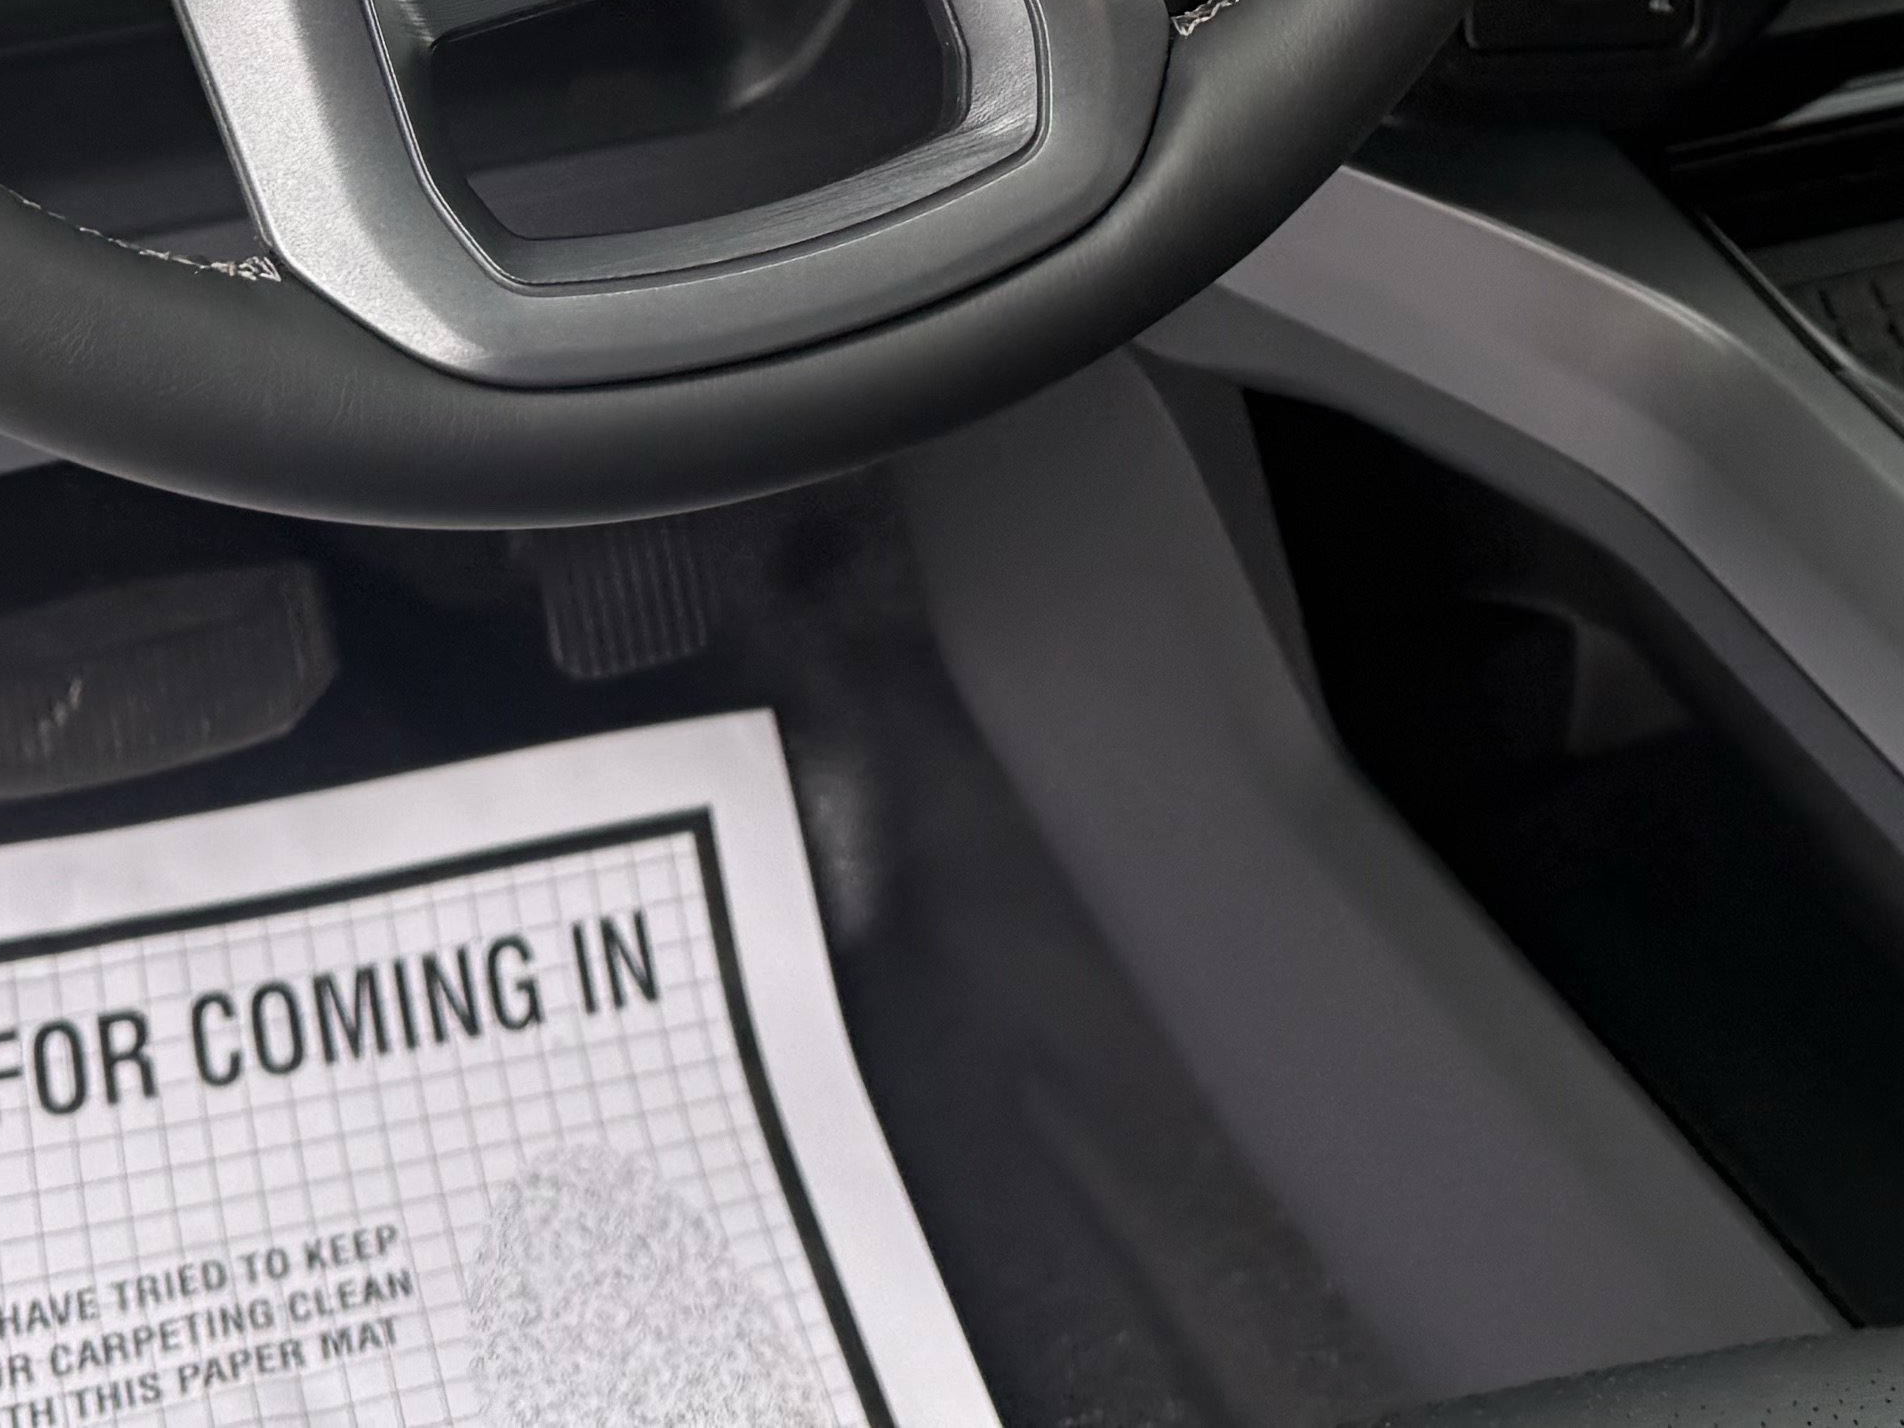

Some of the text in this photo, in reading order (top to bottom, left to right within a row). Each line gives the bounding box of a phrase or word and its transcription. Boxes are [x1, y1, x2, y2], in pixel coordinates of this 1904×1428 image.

[190, 932, 545, 1087] COMING
[571, 907, 663, 1016] IN
[110, 1260, 228, 1314] TRIED
[241, 1246, 291, 1285] TO
[304, 1223, 399, 1273] KEEP
[50, 1298, 274, 1378] CARPETING
[288, 1268, 414, 1324] CLEAN
[73, 1370, 163, 1421] THIS
[177, 1337, 308, 1396] PAPER
[319, 1315, 399, 1362] MAT
